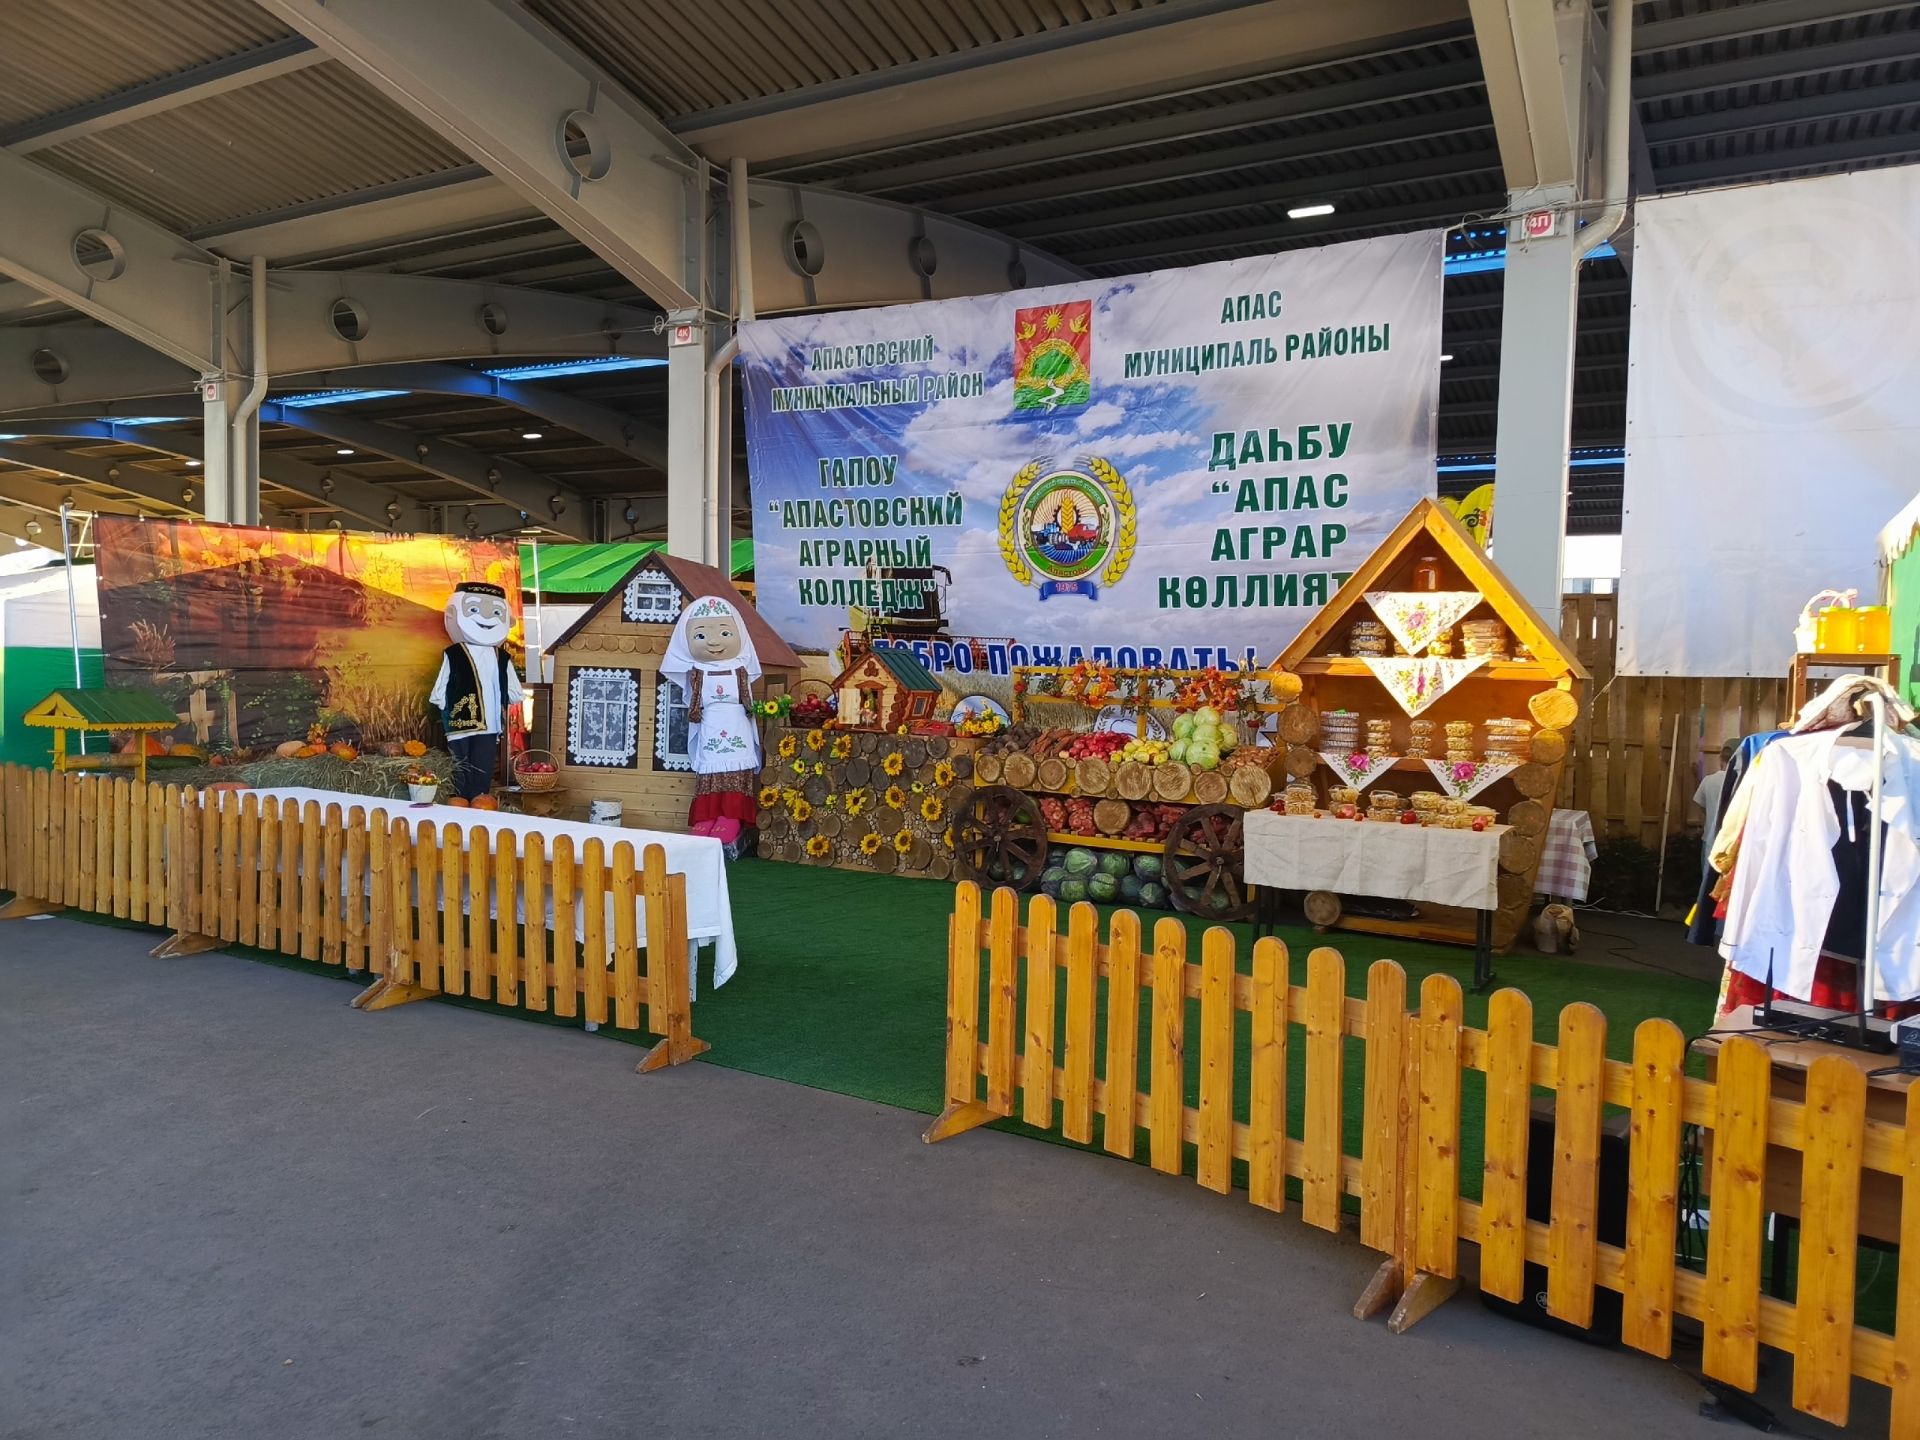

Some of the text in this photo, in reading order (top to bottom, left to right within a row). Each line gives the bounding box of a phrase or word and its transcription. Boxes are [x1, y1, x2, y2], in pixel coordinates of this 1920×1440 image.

[1221, 290, 1282, 324] АПАС
[811, 334, 935, 372] АПАСТОВСКИЙ
[1123, 322, 1390, 379] МУНИЦИПАЛЬ РАЙОНЫ
[923, 371, 984, 401] РАЙОН
[819, 455, 898, 488] ГАПОУ
[769, 490, 964, 529] “АПАСТОВСКИЙ
[1211, 473, 1349, 513] “АПАС
[799, 534, 933, 568] АГРАРНЫЙ
[1210, 523, 1348, 562] АГРАР
[798, 577, 937, 613] КОЛЛЕДЖ”
